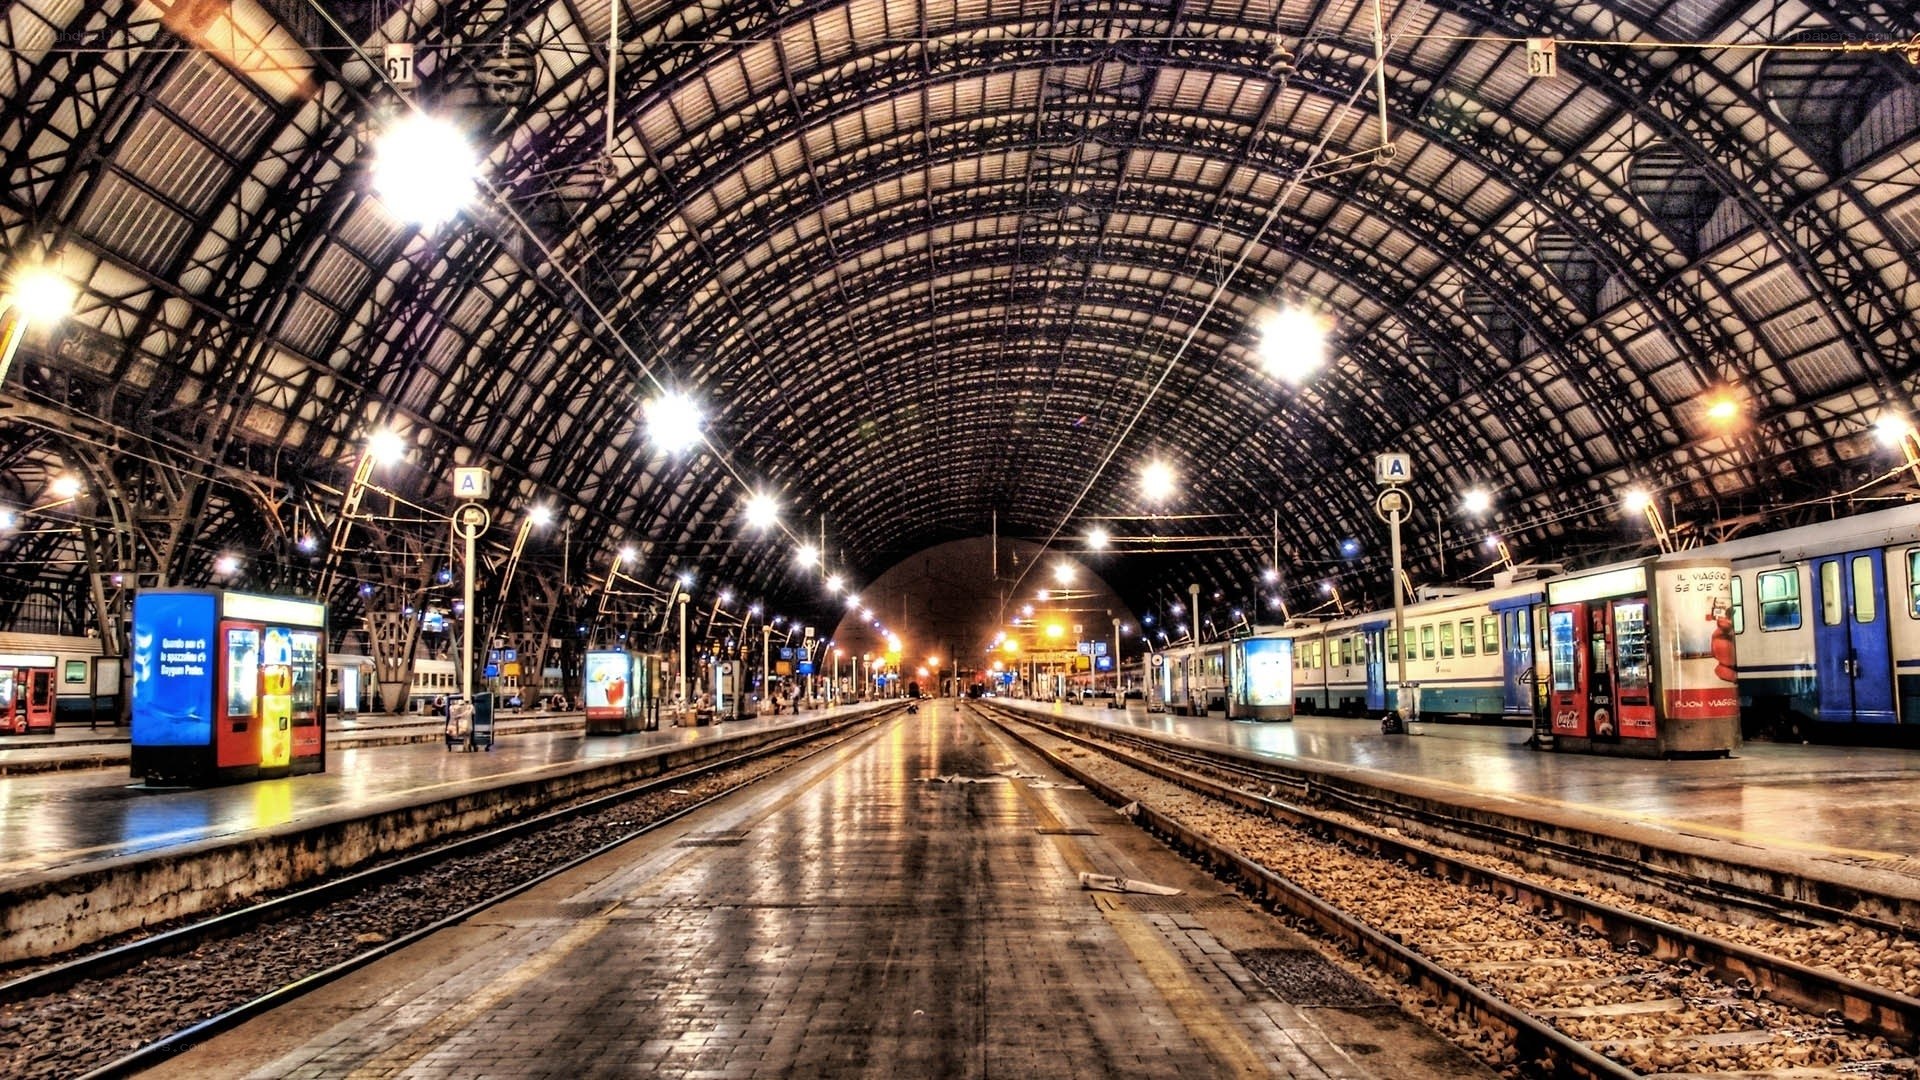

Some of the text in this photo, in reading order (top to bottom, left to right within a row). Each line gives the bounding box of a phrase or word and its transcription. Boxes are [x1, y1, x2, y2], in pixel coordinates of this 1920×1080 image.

[1390, 459, 1404, 475] A
[461, 474, 475, 490] A
[1675, 584, 1690, 592] SE
